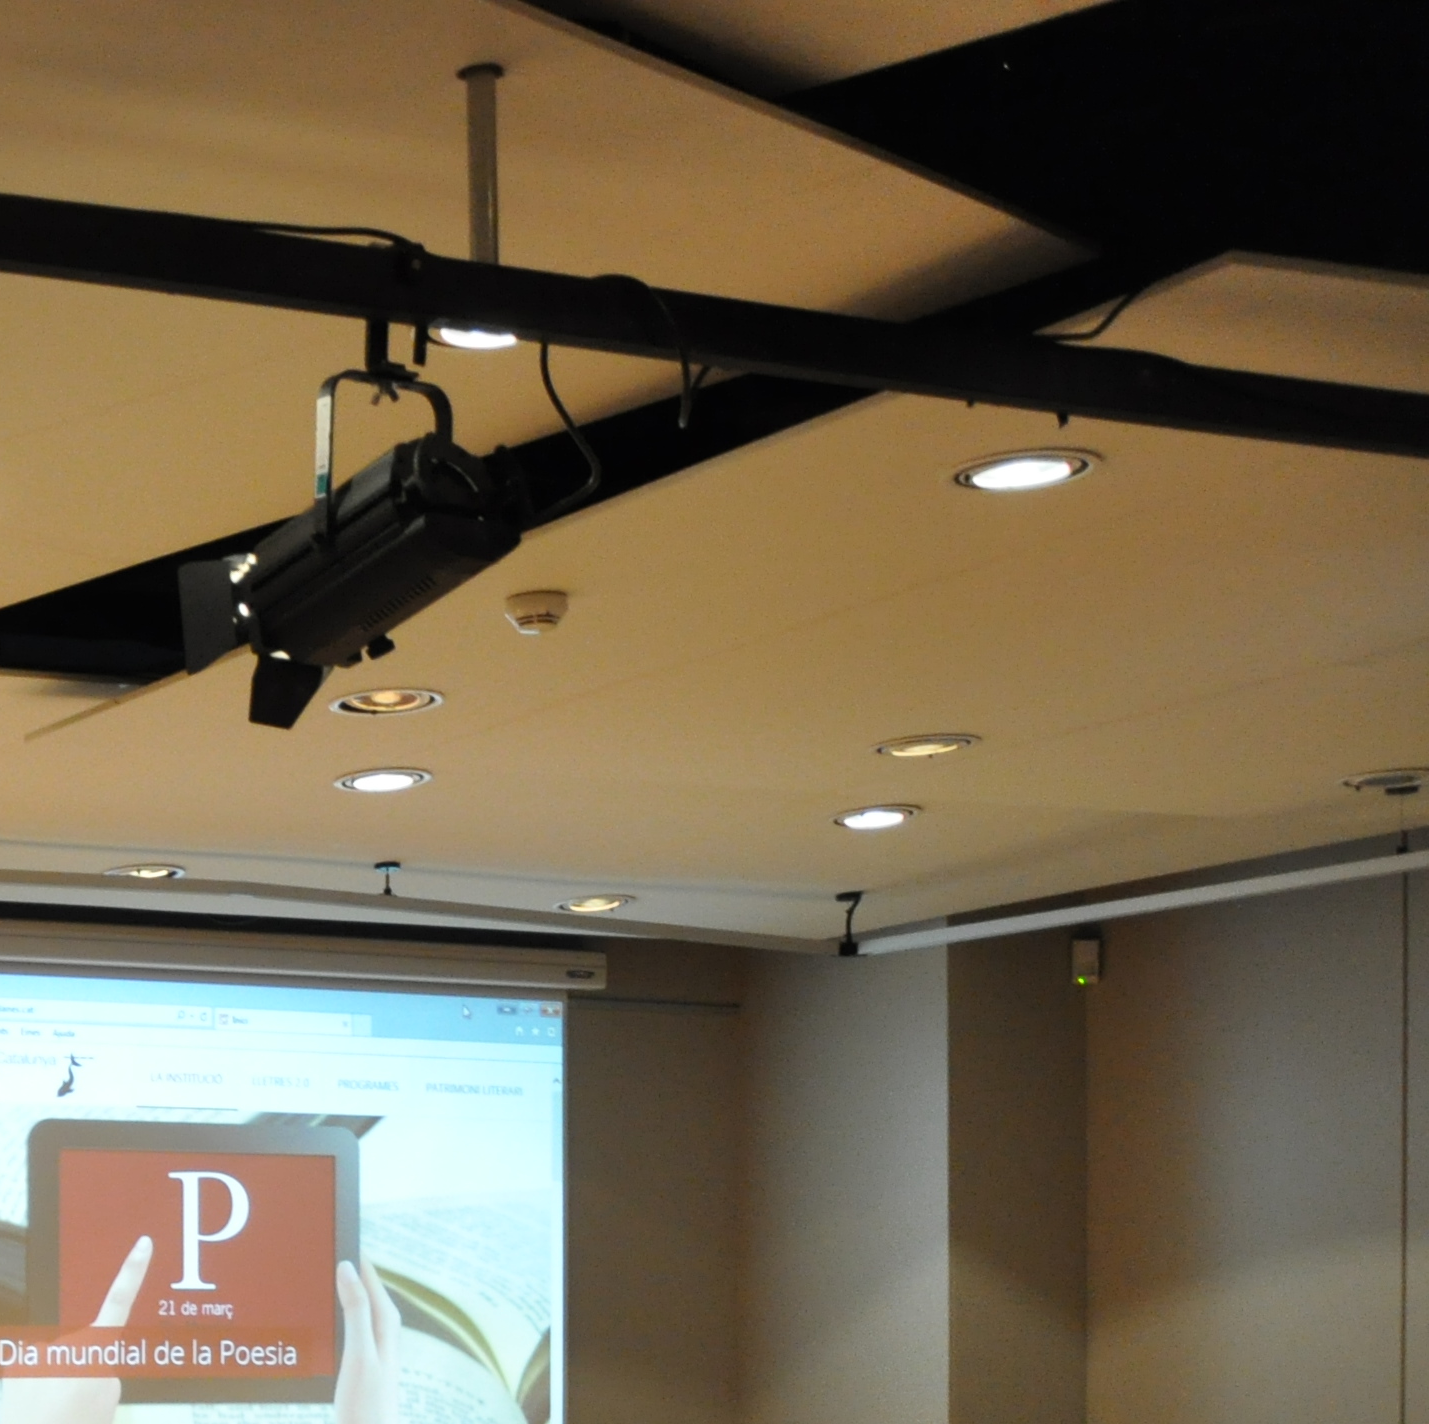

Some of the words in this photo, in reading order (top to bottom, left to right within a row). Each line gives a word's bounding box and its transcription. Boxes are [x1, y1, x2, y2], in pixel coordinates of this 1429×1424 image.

[168, 1171, 250, 1291] P
[159, 1301, 176, 1316] 21
[181, 1301, 198, 1317] de
[202, 1302, 233, 1319] març
[47, 1340, 147, 1366] mundial
[154, 1340, 185, 1366] de
[192, 1340, 212, 1366] la
[220, 1341, 297, 1366] Poesia
